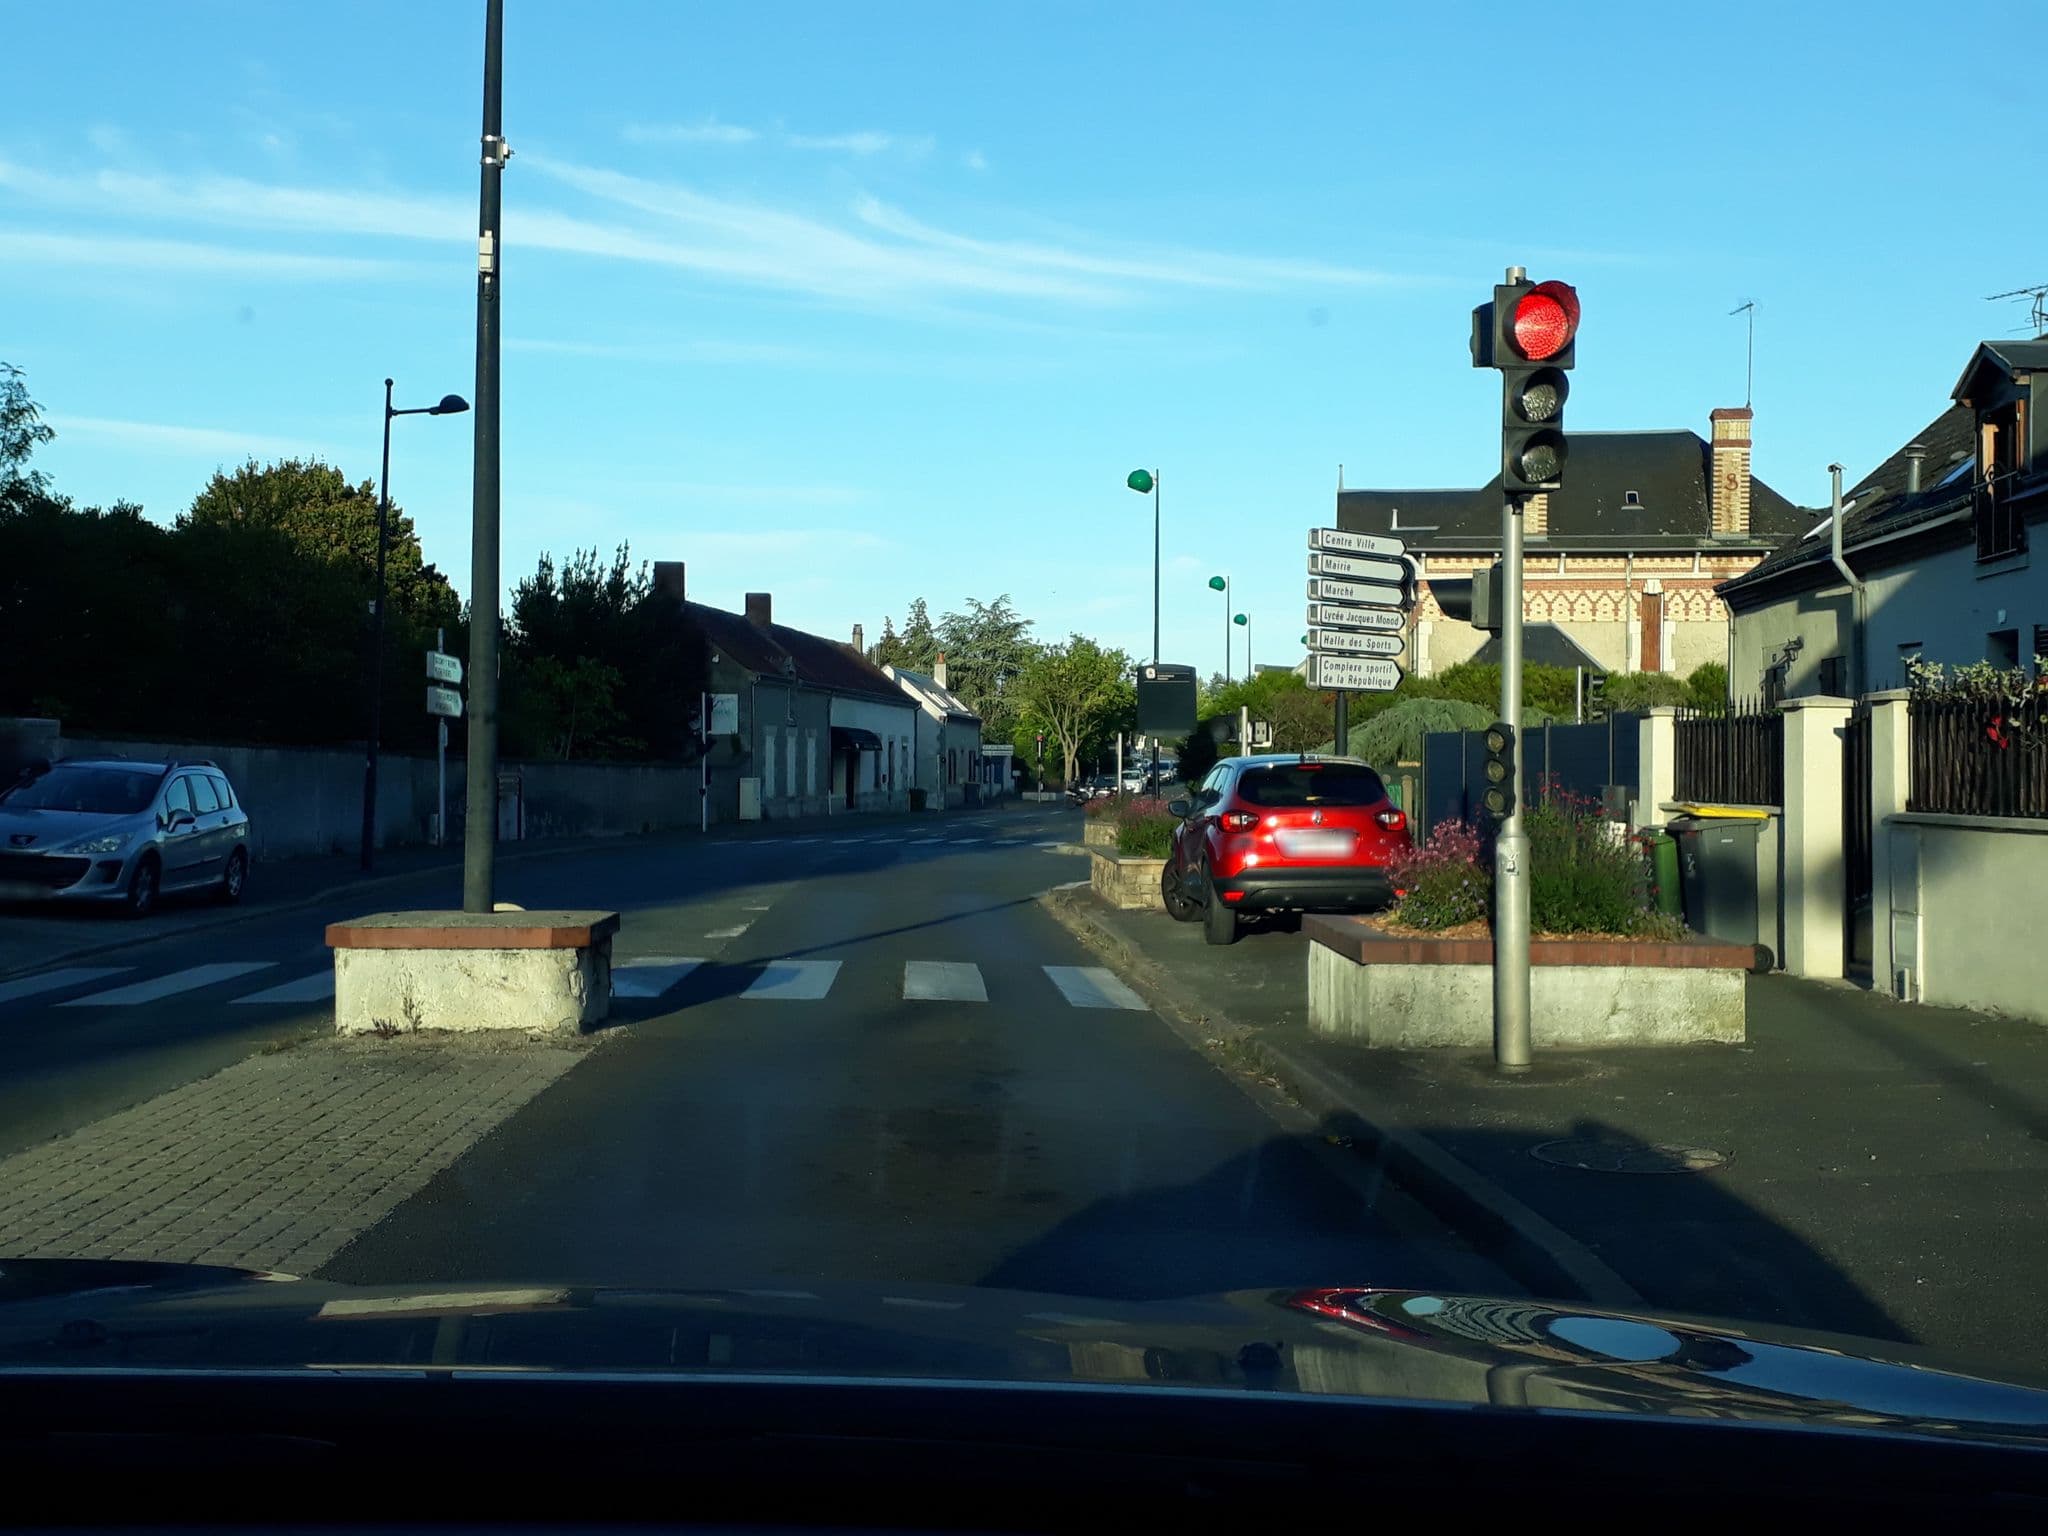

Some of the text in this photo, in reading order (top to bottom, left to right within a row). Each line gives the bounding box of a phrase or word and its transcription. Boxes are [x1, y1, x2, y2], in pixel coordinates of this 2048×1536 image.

[1325, 534, 1376, 550] Centre Ville
[1325, 560, 1352, 572] Mairie
[1325, 584, 1354, 597] Marché
[1324, 609, 1399, 626] Lycée Jacques Monod
[1324, 634, 1392, 650] Halle des Sports
[1324, 660, 1393, 675] Complexe sportif
[1324, 672, 1392, 688] de la République
